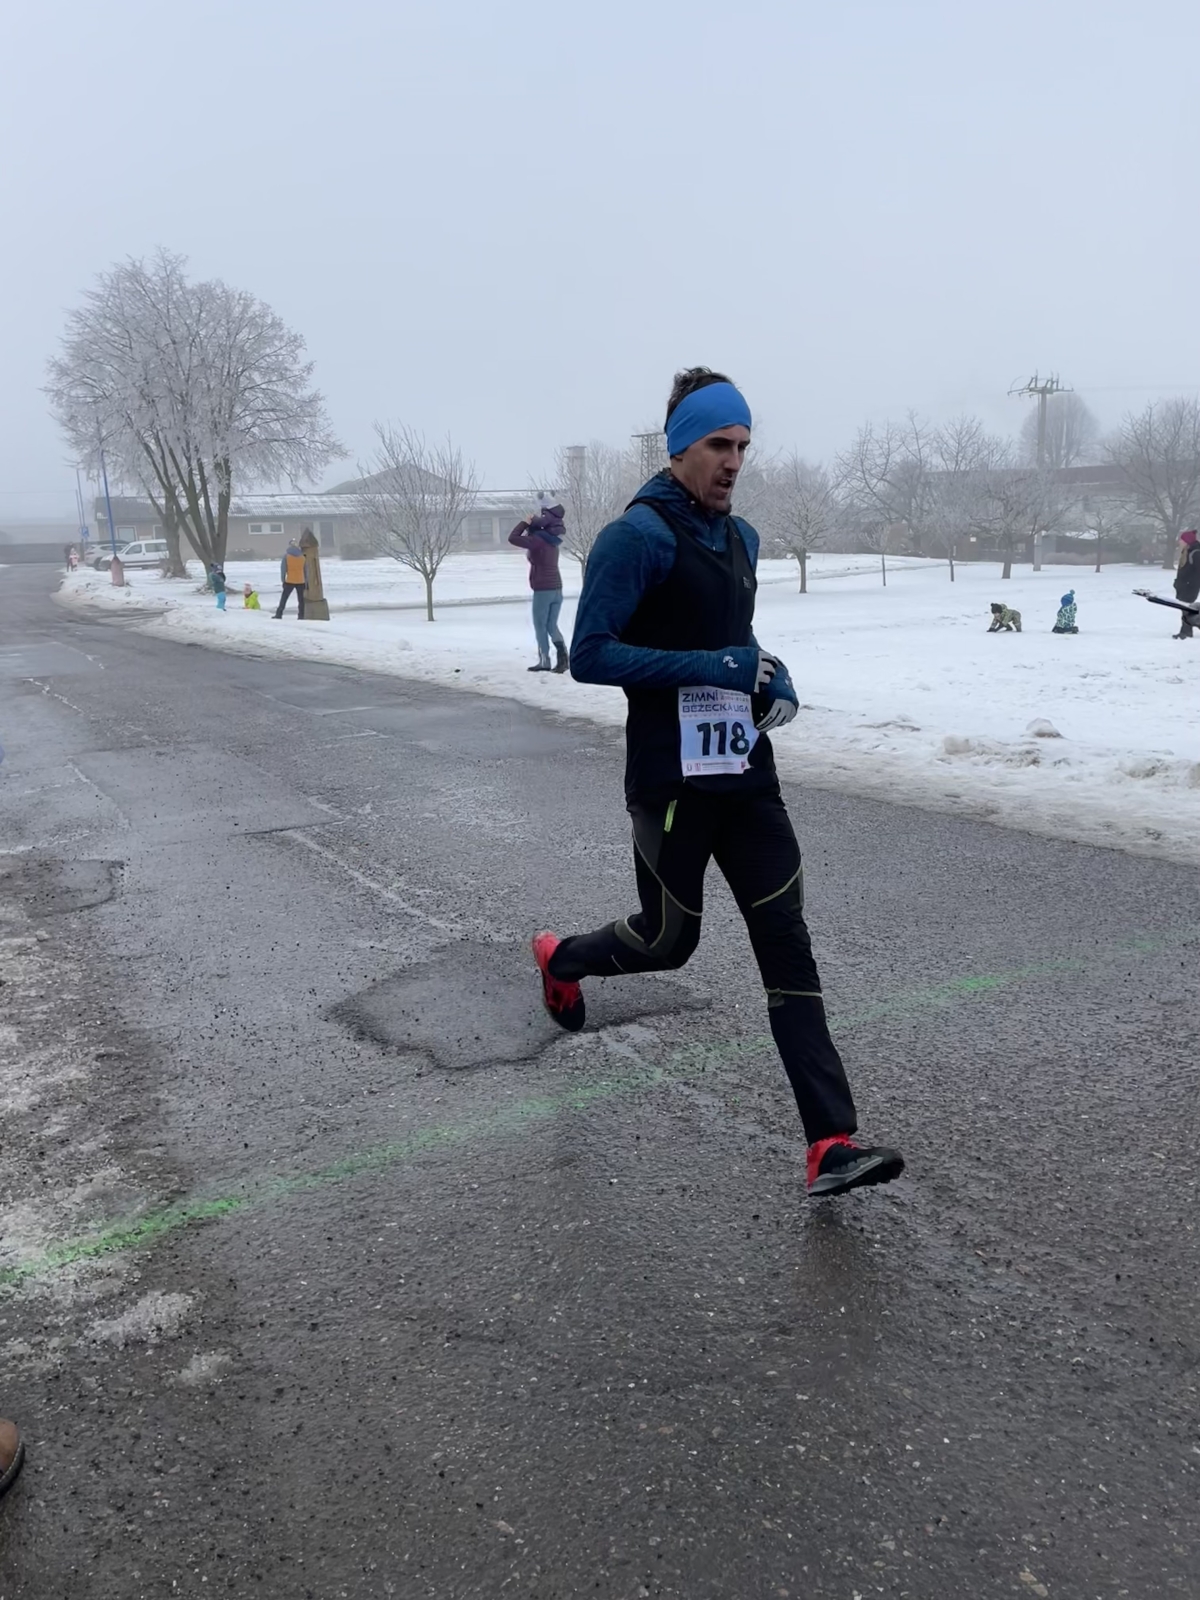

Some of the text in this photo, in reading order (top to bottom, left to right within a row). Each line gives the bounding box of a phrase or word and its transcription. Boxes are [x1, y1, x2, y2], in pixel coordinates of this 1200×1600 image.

[682, 690, 718, 702] ZIMNÍ
[734, 704, 749, 713] LIGA
[696, 721, 750, 756] 118
